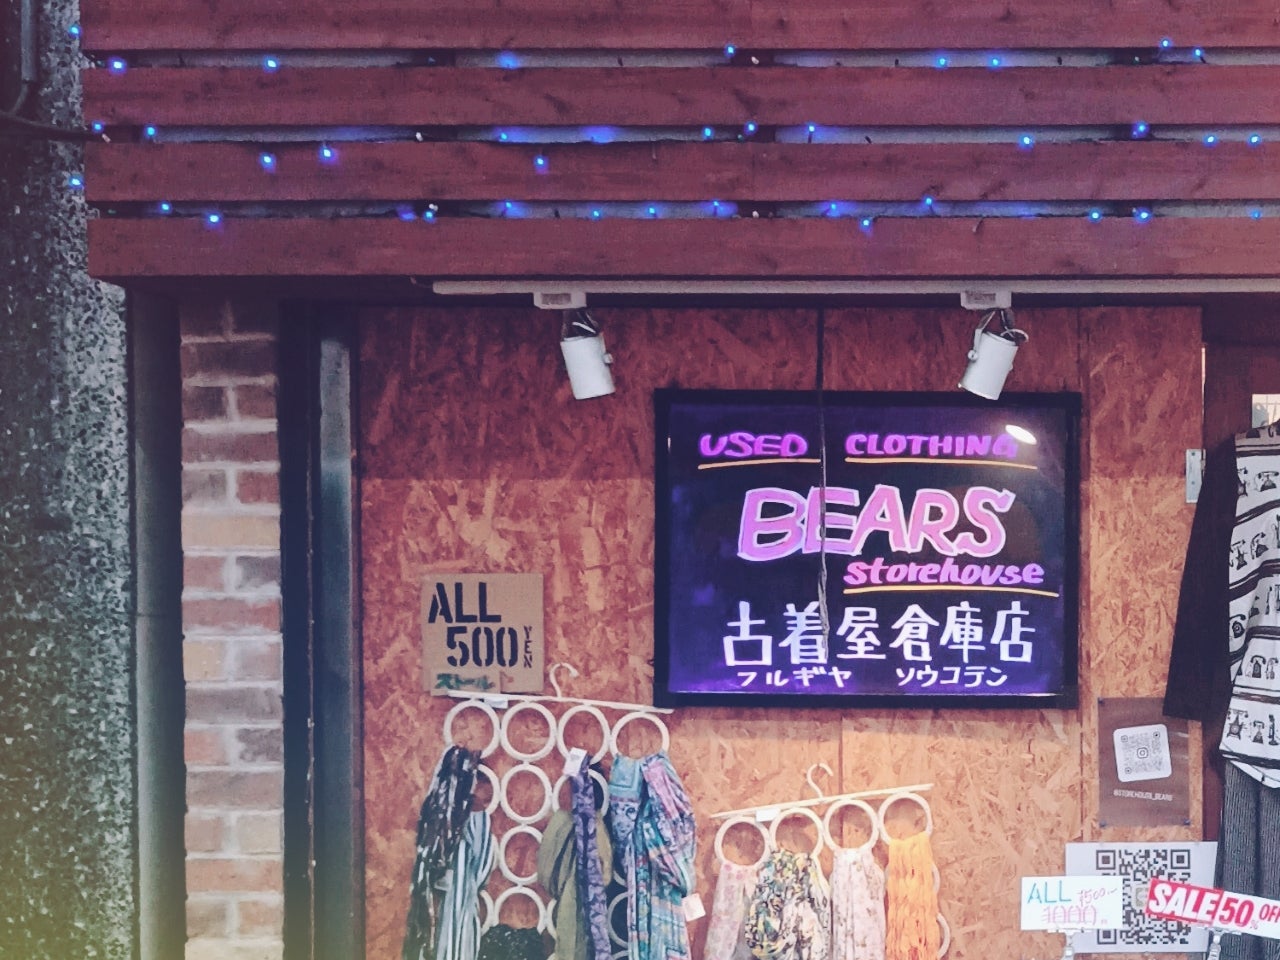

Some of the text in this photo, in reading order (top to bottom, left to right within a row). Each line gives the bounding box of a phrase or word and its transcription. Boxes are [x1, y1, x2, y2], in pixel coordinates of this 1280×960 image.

[699, 432, 1021, 458] USED CLOTHING
[737, 484, 1016, 562] BEARS
[427, 581, 502, 624] ALL
[446, 625, 533, 669] 500 YEN
[722, 600, 1036, 667] 古着屋倉庫店
[737, 665, 1008, 688] フルギヤ ソウコテン
[1027, 880, 1072, 904] ALL
[1148, 882, 1221, 923] SALE
